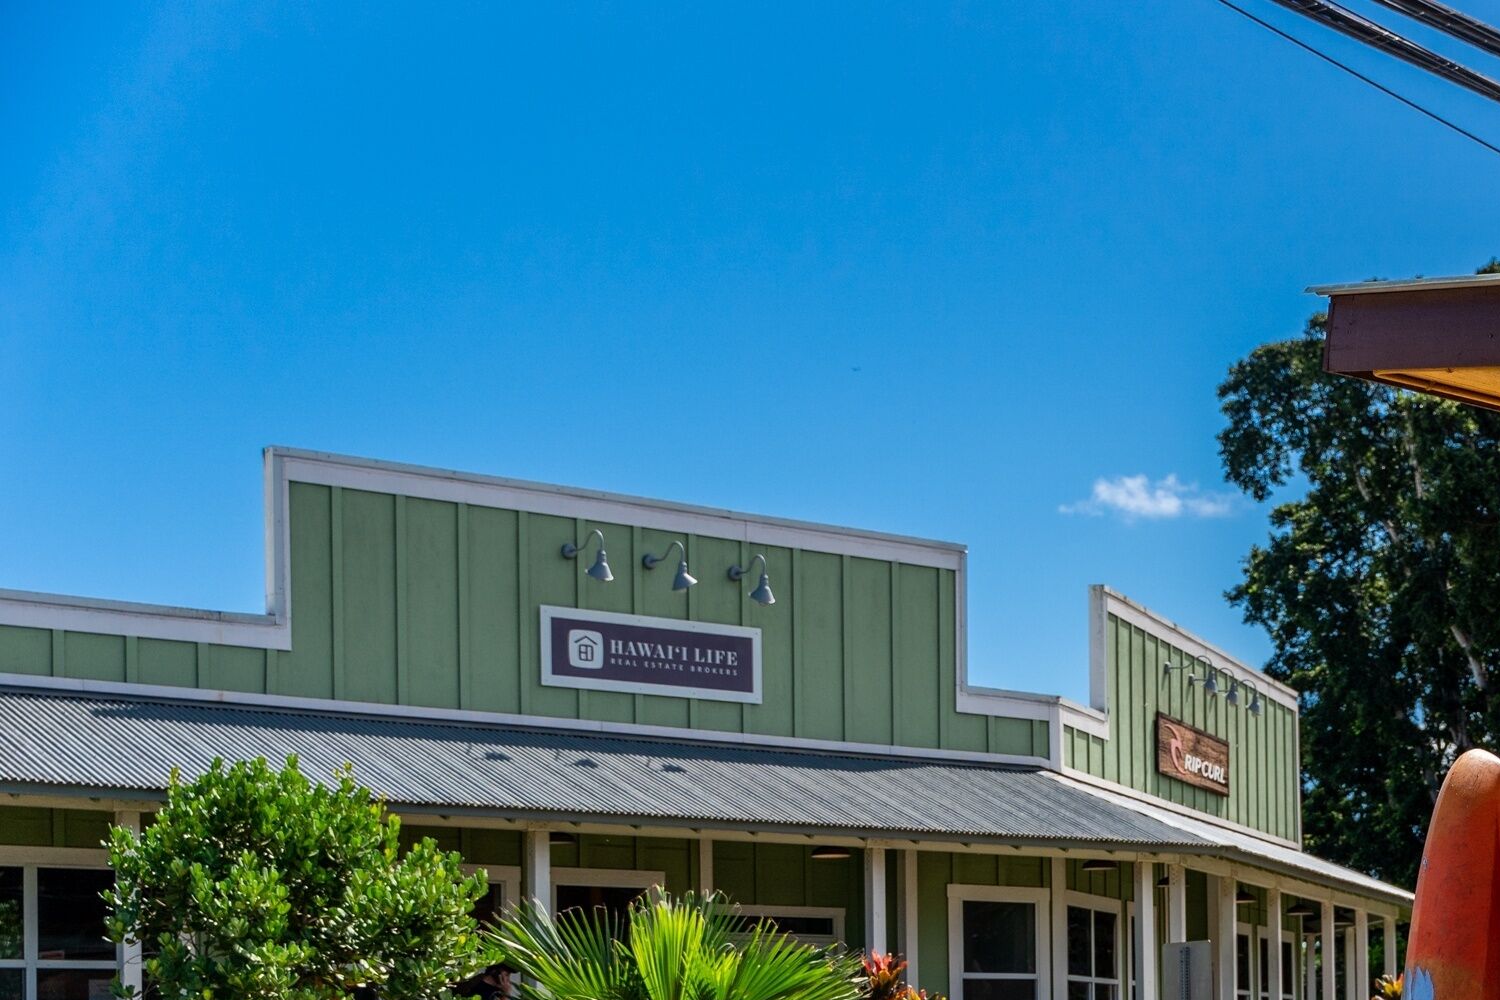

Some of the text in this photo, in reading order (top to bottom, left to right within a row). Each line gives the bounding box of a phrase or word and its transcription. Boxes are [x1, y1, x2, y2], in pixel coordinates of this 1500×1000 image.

[694, 648, 738, 666] LIFE
[610, 658, 738, 676] REAL ESTATE BROKERS
